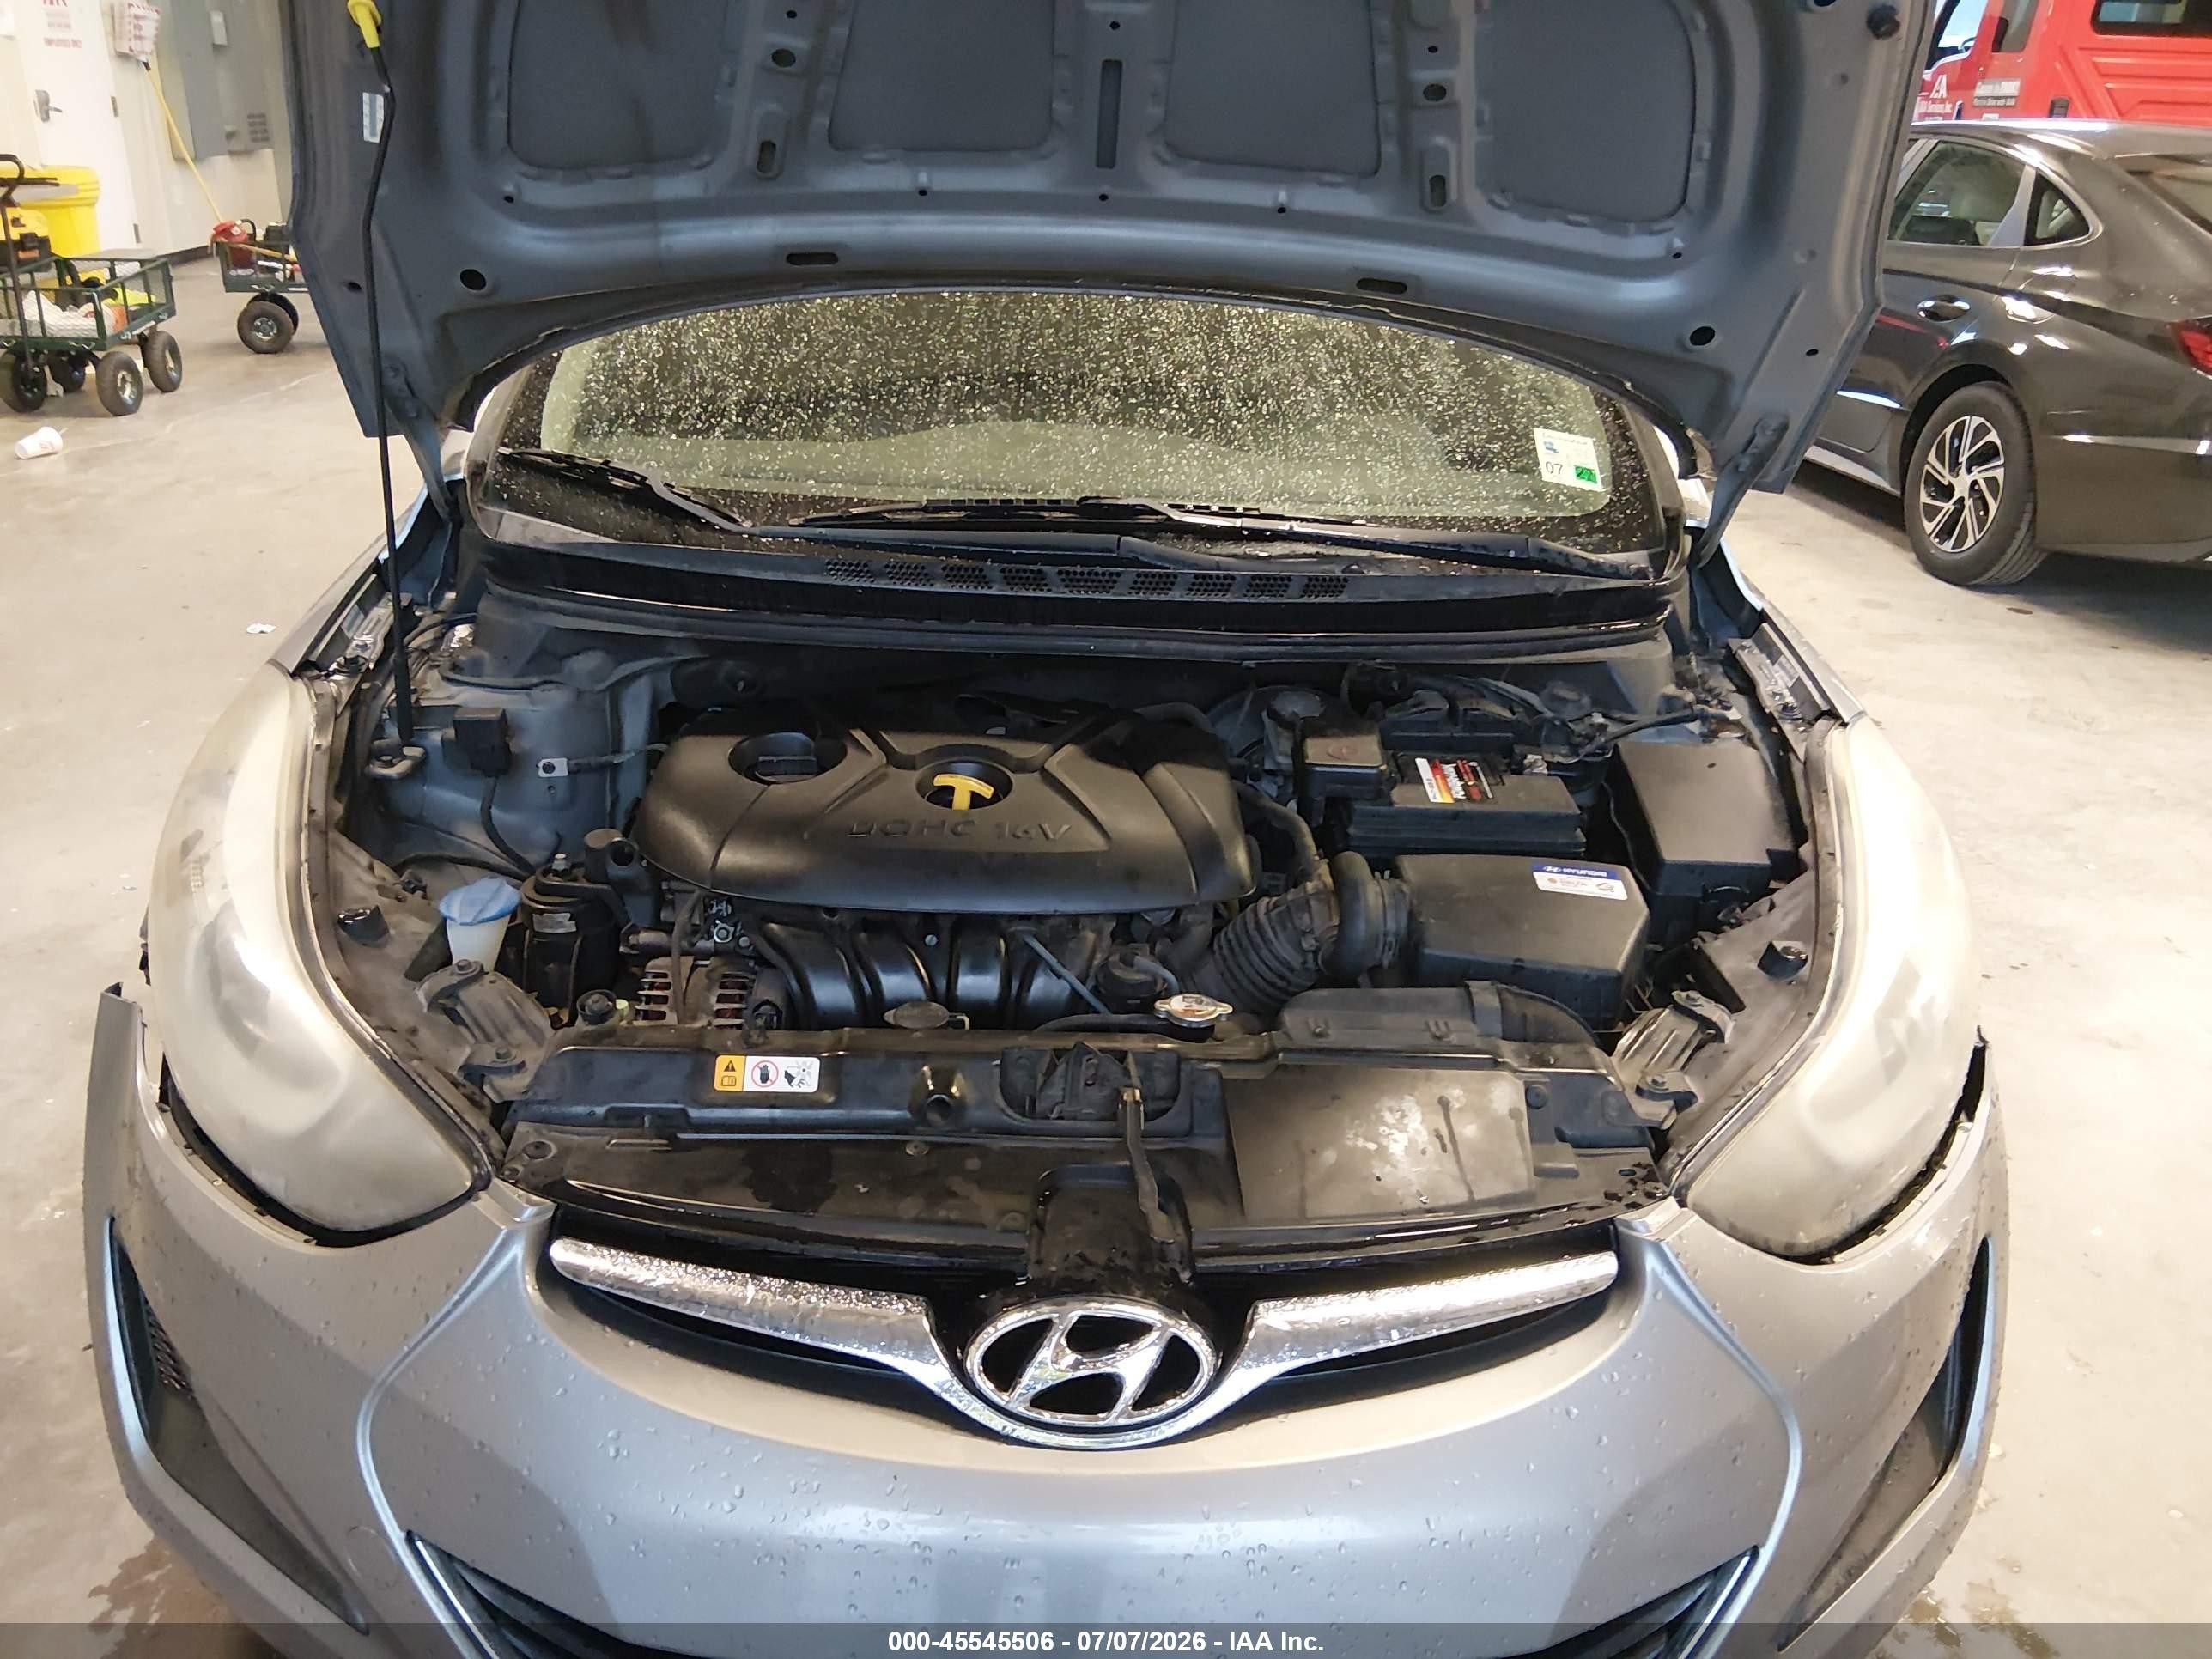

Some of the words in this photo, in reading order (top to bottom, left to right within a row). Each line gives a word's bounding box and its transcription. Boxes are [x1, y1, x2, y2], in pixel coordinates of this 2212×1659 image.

[1546, 461, 1563, 474] 07
[846, 819, 975, 838] DOHC
[996, 819, 1072, 841] 16V
